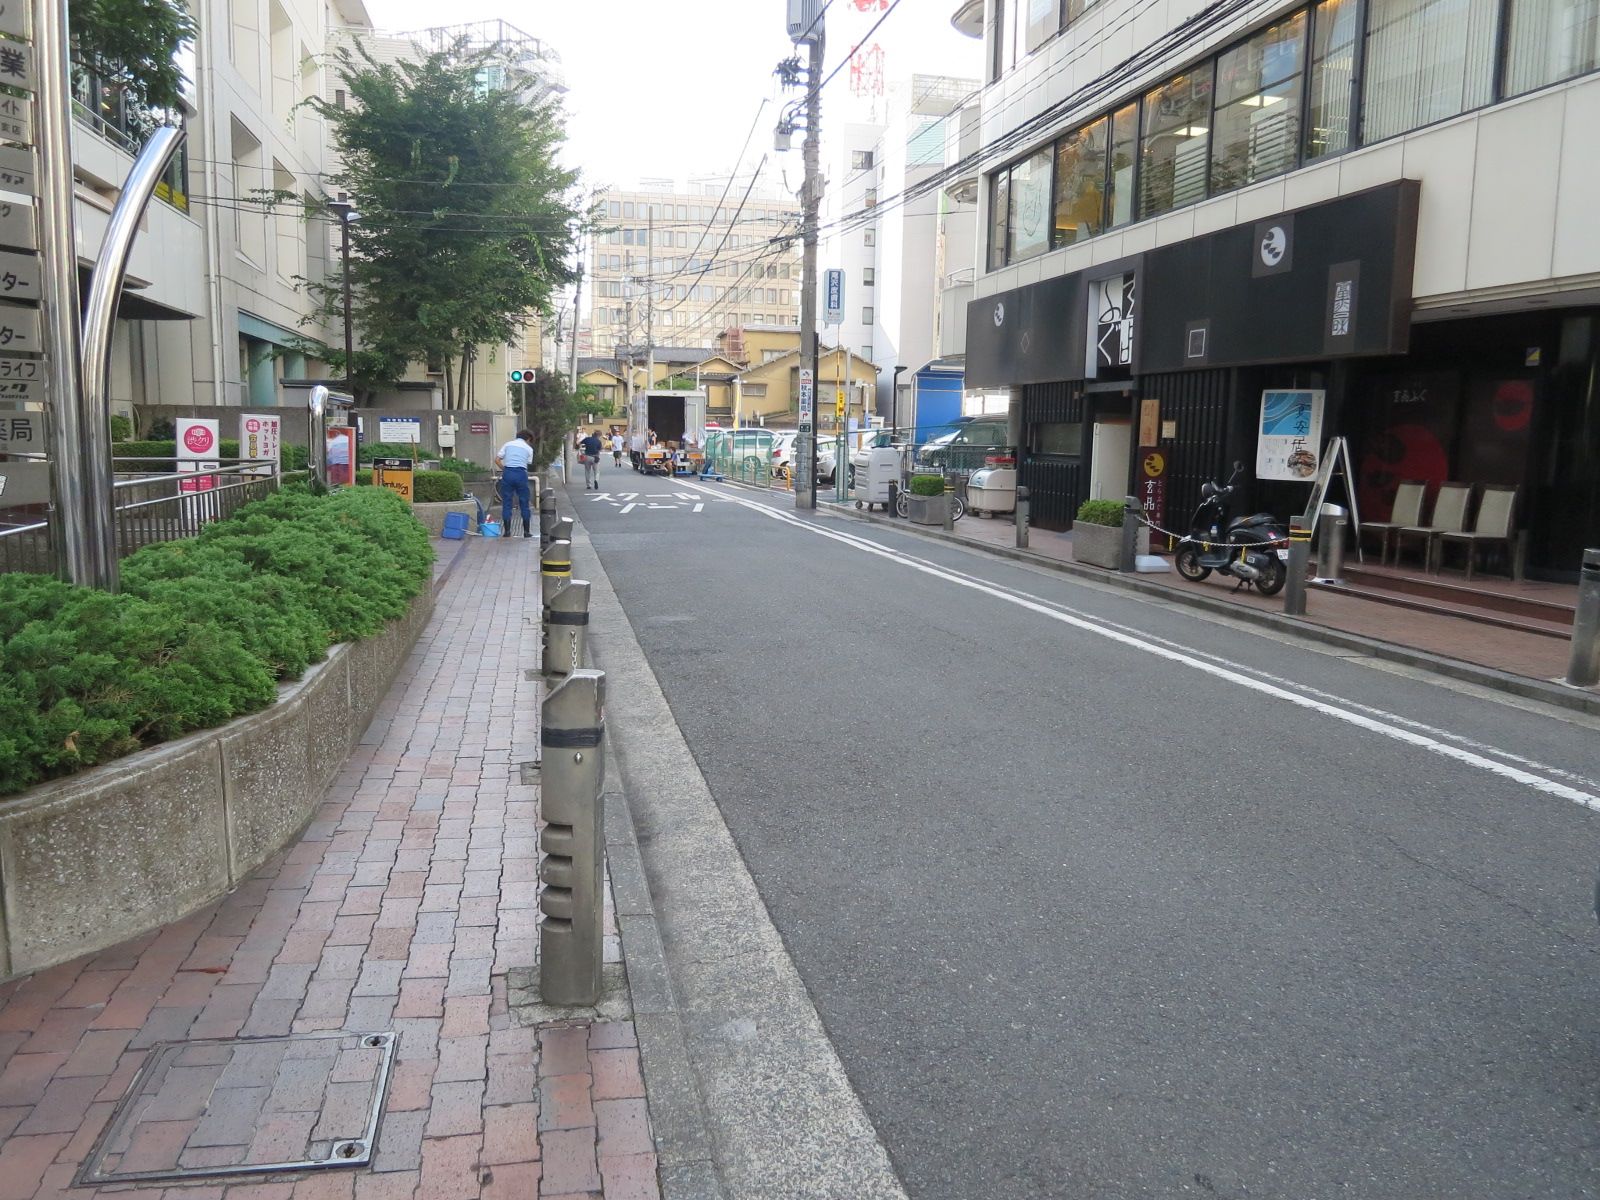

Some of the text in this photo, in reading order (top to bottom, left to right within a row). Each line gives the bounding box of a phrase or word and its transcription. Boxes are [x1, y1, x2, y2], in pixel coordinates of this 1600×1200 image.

[582, 492, 702, 502] スクール
[608, 502, 705, 514] ゾーン
